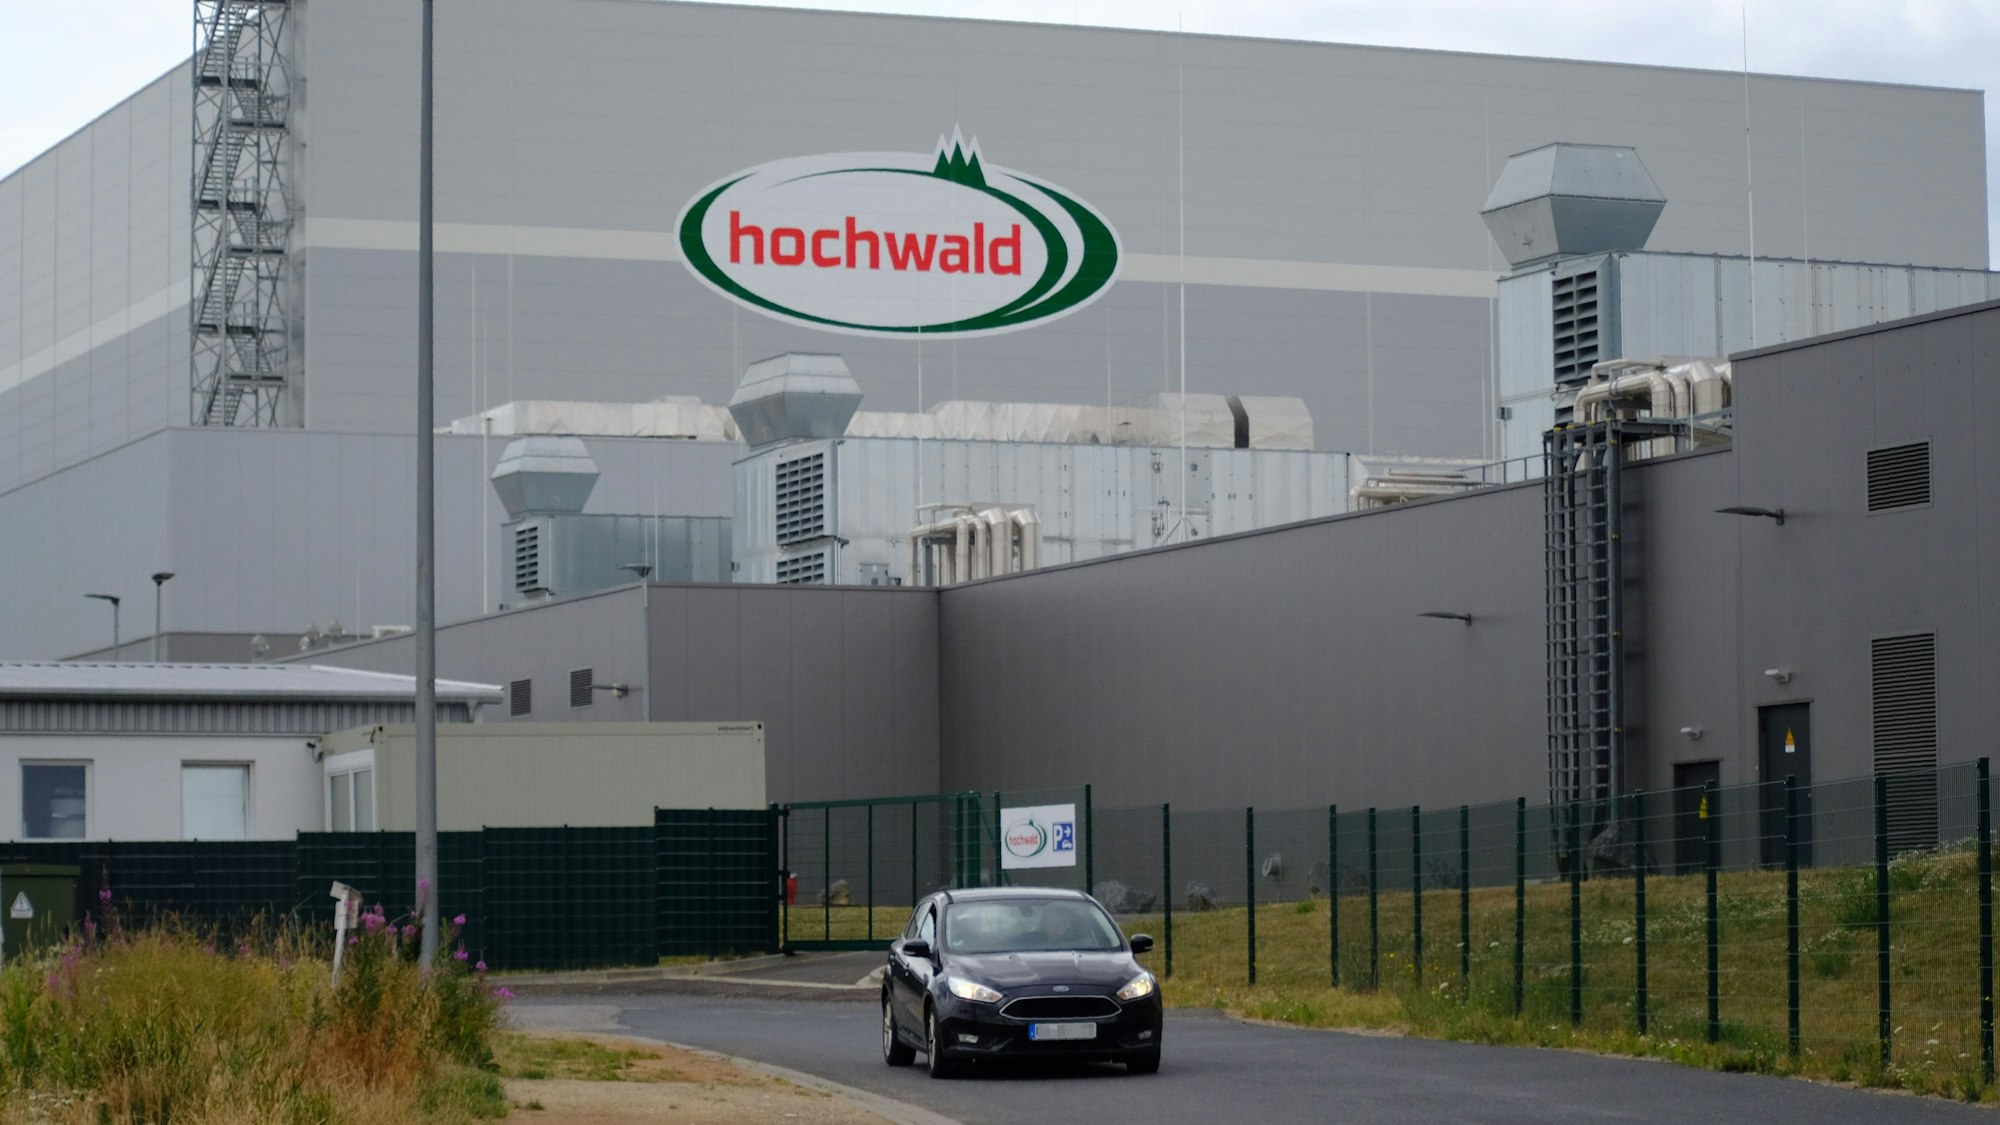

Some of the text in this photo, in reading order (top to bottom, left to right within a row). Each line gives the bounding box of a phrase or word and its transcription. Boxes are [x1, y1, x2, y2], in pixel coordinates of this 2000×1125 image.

[729, 210, 1021, 275] hochwald
[1008, 834, 1038, 846] hochwald
[1053, 824, 1063, 850] P
